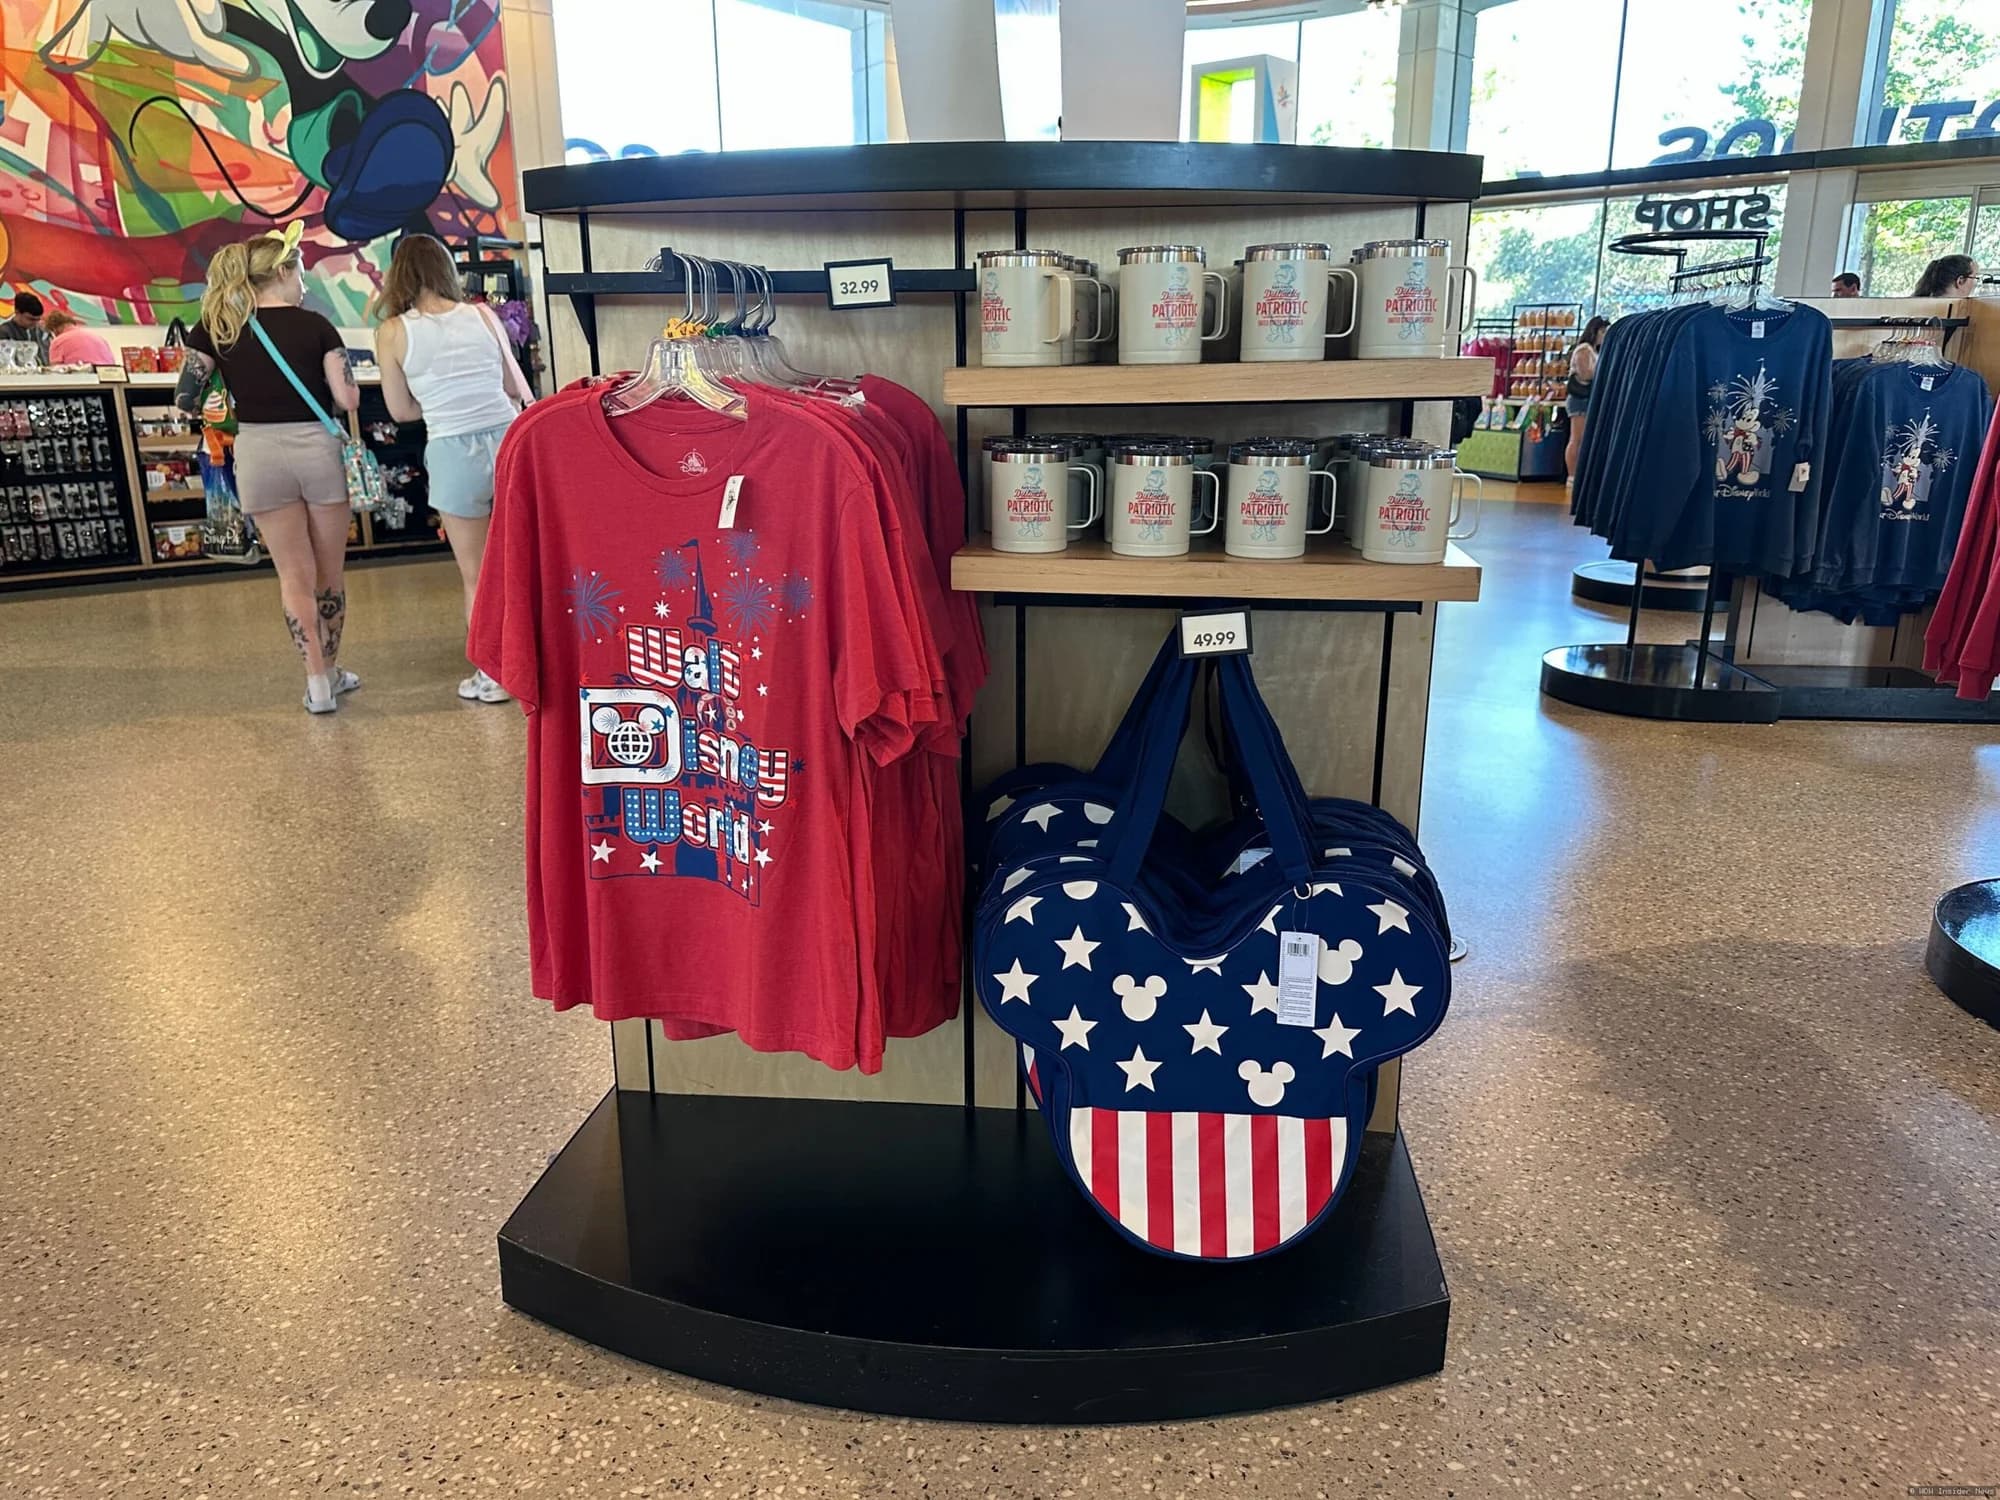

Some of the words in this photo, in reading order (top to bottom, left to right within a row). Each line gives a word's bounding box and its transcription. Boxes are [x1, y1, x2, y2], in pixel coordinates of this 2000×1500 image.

[839, 279, 879, 295] 32.99
[1152, 303, 1198, 318] PATRIOTIC
[1256, 300, 1308, 315] PATRIOTIC
[1385, 298, 1438, 313] PATRIOTIC
[982, 307, 1012, 322] RIOTIC
[1007, 499, 1054, 514] PATRIOTIC
[1128, 502, 1176, 516] PATRIOTIC
[1240, 502, 1290, 517] PATRIOTIC
[1378, 506, 1431, 521] PATRIOTIC
[1193, 631, 1236, 647] 49.99
[625, 624, 742, 701] Walt
[579, 686, 790, 809] Disney
[622, 786, 751, 866] World
